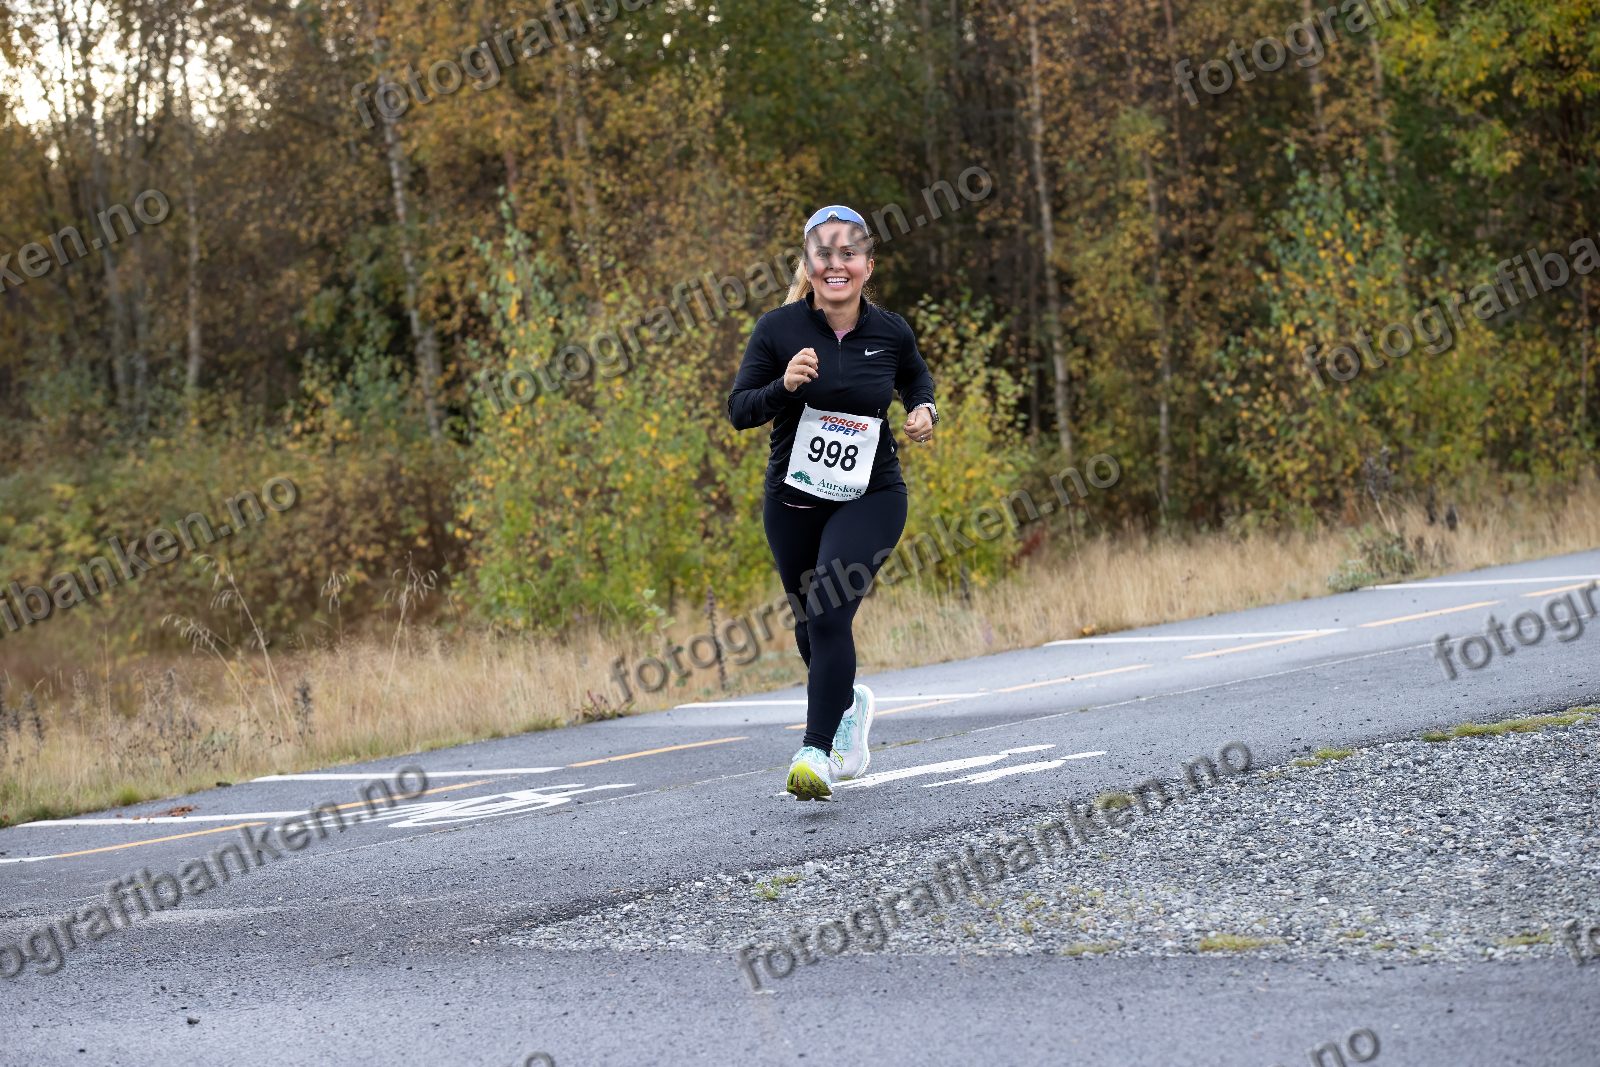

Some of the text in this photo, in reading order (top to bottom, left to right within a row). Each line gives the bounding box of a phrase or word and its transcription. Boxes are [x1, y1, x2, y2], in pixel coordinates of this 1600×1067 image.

[819, 415, 869, 432] NORGES
[821, 422, 860, 437] LØPET
[807, 436, 859, 472] 998
[817, 478, 862, 497] Aurskog
